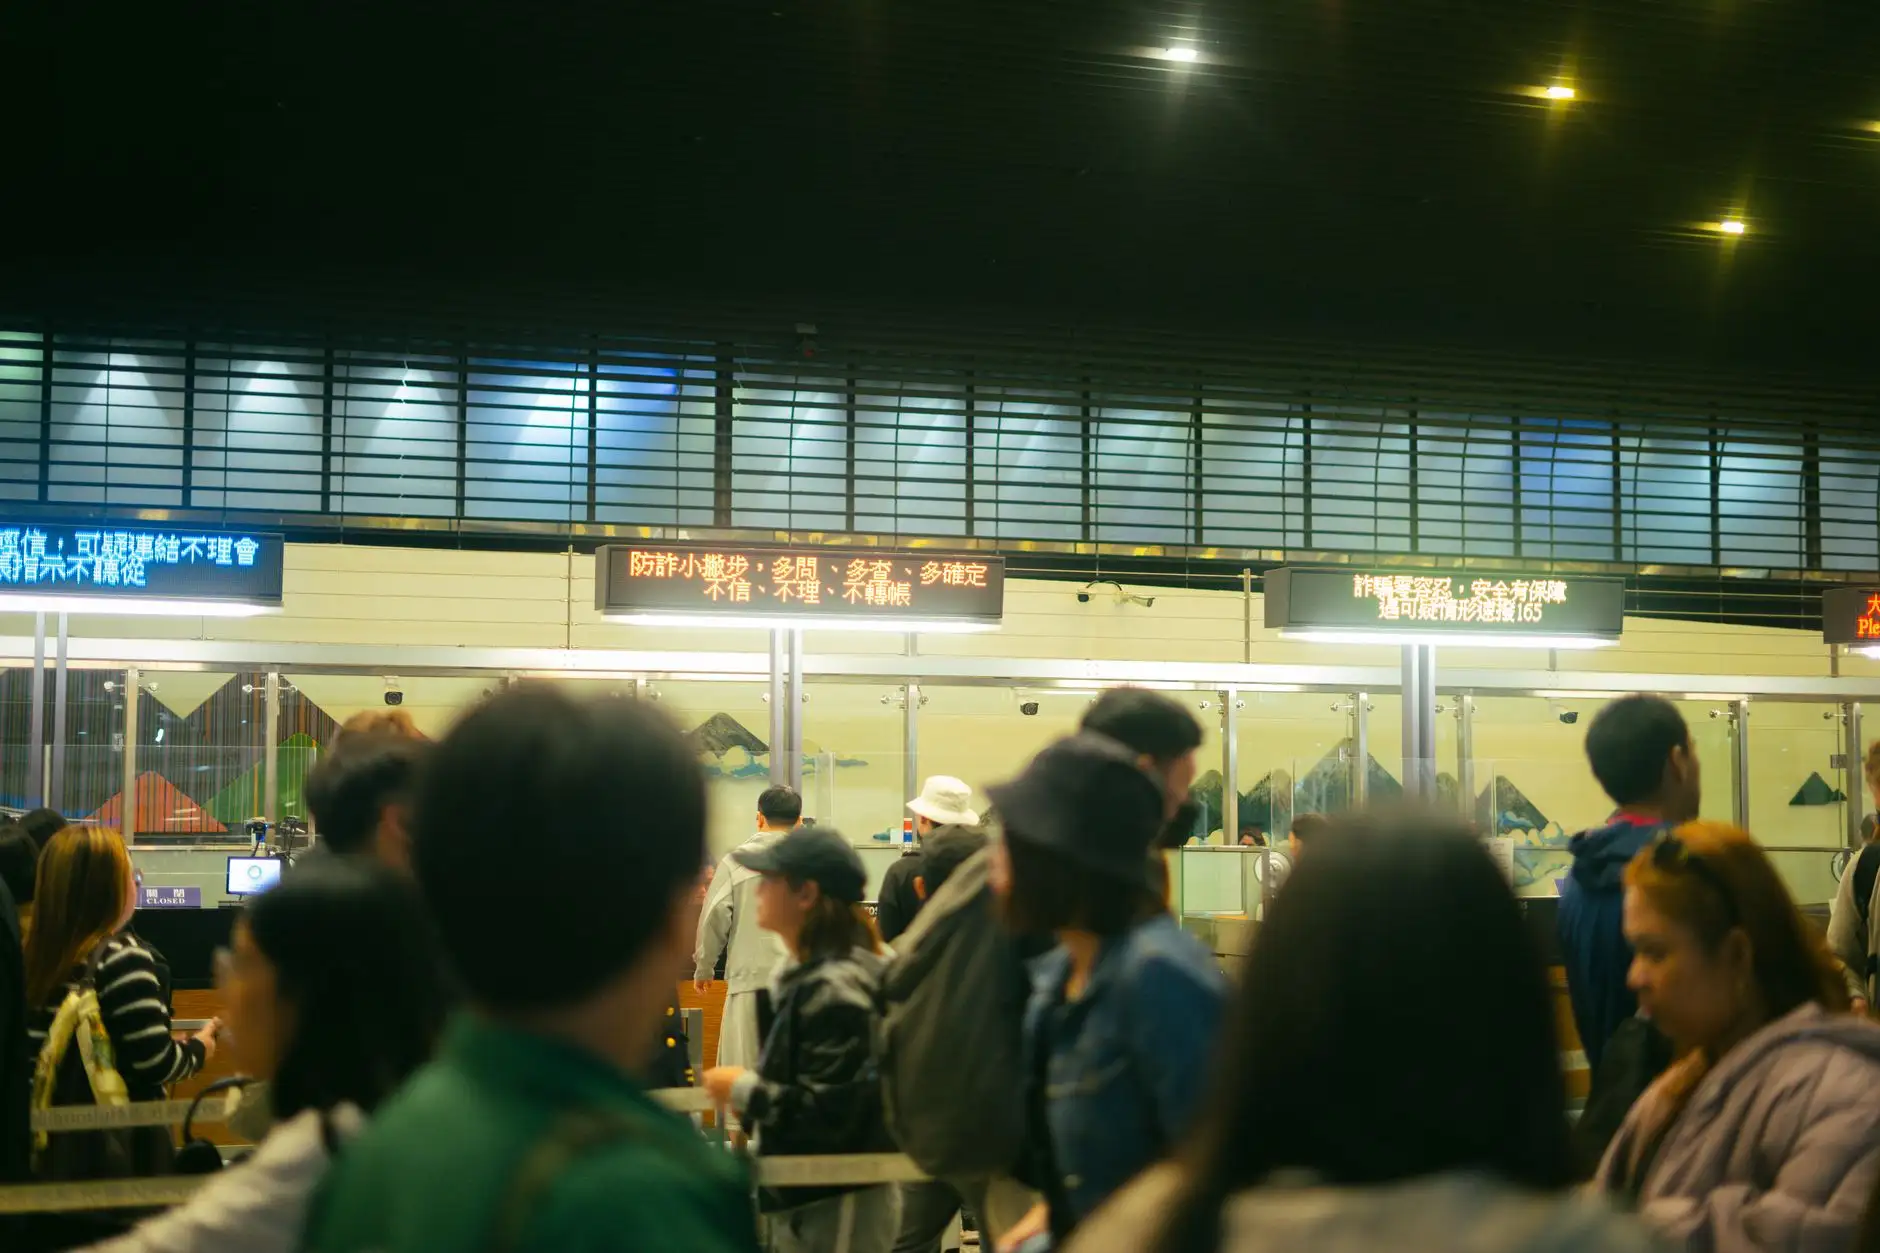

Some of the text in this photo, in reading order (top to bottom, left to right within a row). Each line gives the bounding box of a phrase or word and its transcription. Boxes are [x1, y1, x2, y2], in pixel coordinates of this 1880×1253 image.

[704, 577, 912, 606] 不信、不理、不轉帳
[146, 897, 185, 905] CLOSED
